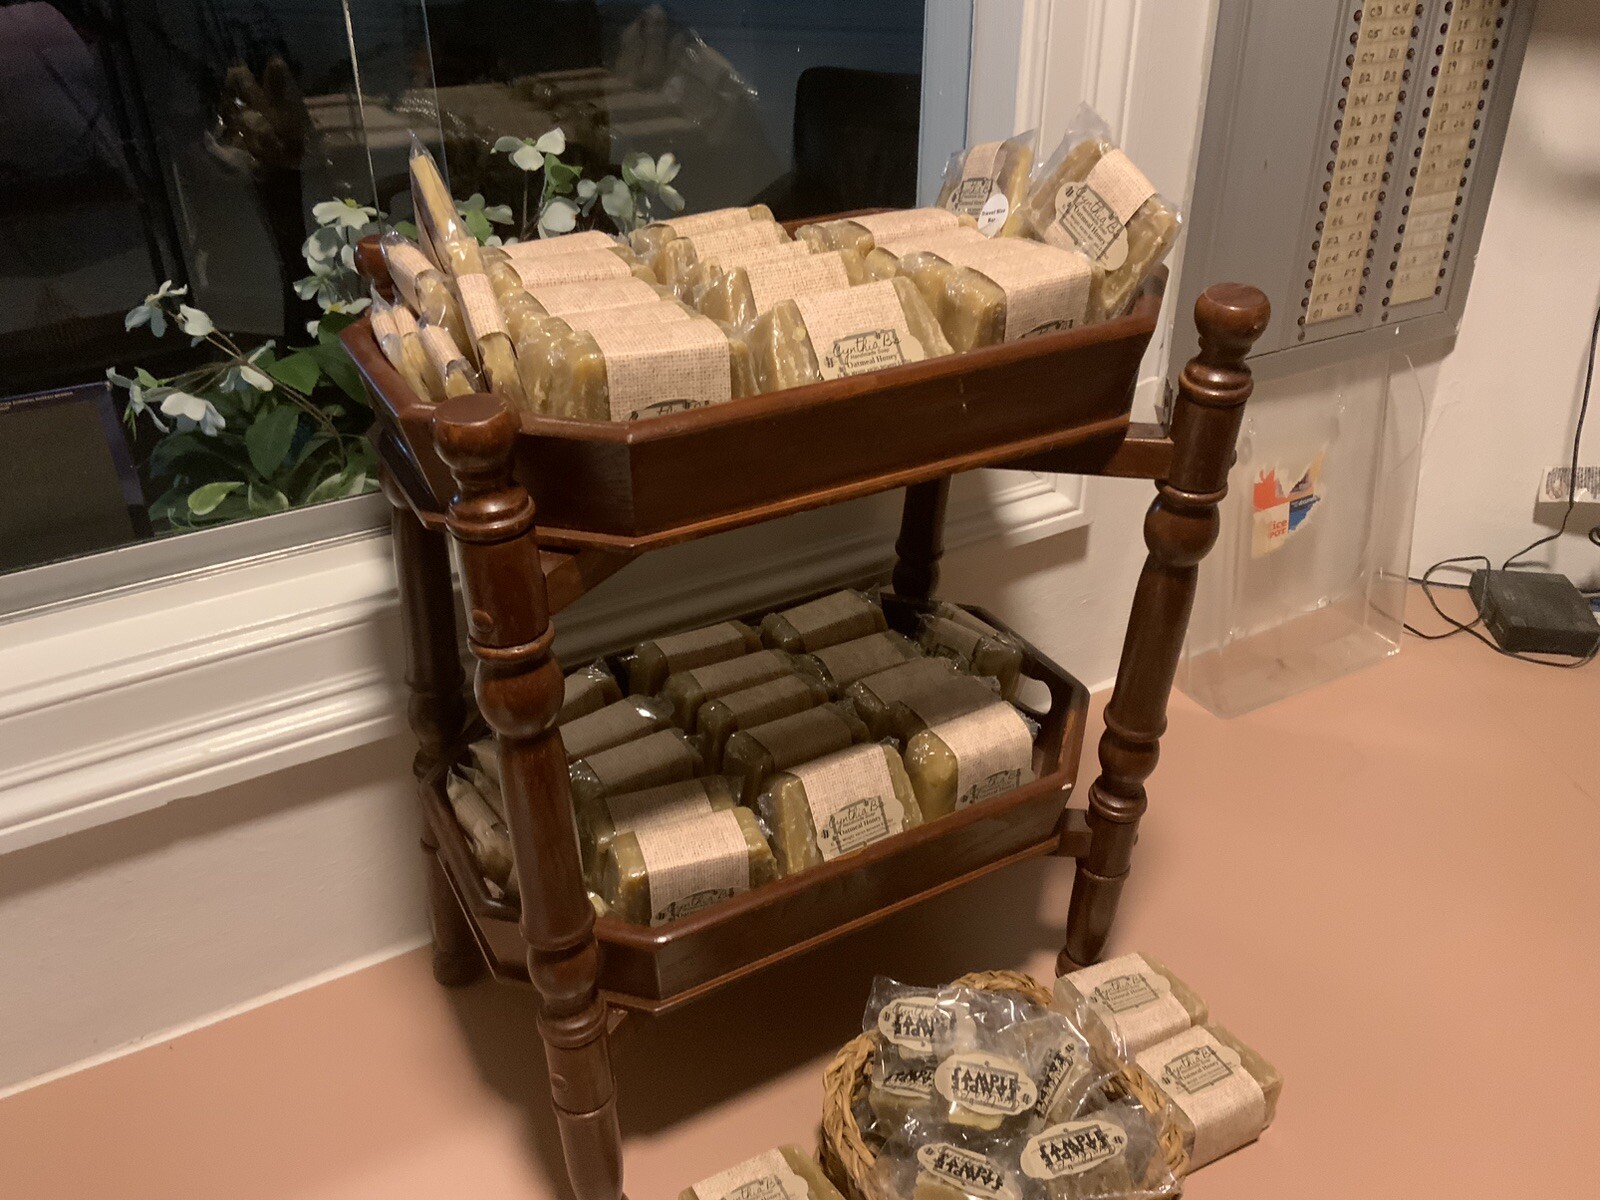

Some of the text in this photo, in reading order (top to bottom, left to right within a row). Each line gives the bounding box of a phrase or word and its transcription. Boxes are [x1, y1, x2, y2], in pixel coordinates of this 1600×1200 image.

[1370, 5, 1383, 17] C3
[1367, 26, 1406, 40] C5 C6
[1039, 1125, 1109, 1168] SAMPLE
